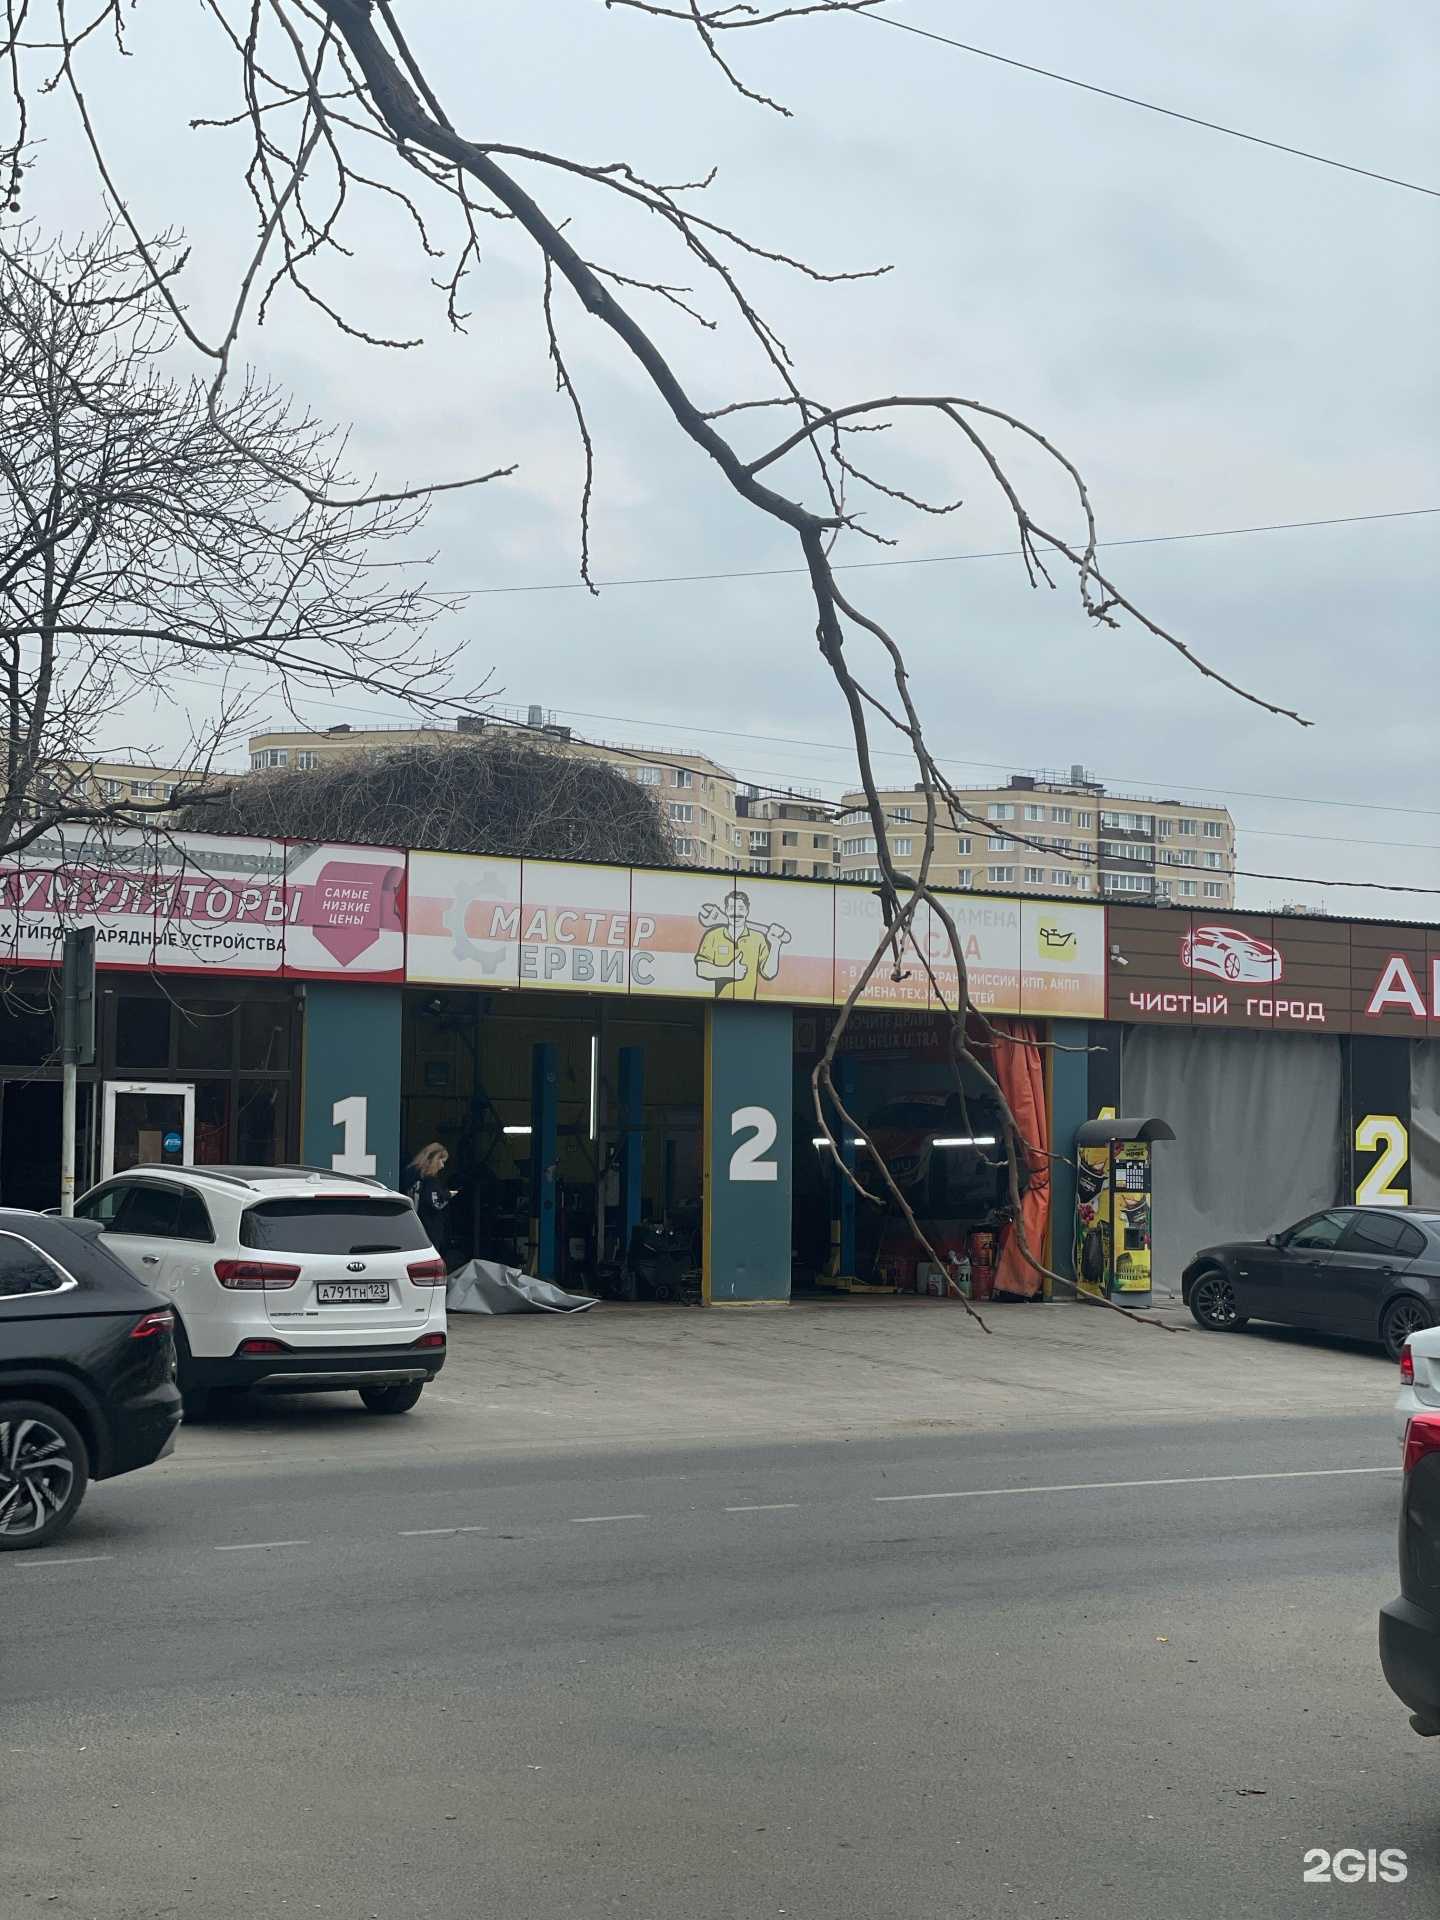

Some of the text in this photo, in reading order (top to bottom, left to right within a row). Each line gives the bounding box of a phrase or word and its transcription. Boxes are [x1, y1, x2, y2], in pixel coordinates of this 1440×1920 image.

[322, 900, 371, 914] НИЗКИЕ
[324, 887, 370, 901] САМЫЕ
[328, 912, 365, 926] ЦЕНЫ
[488, 905, 656, 947] МАСТЕР
[95, 928, 178, 947] АРЯДНЫЕ
[181, 931, 287, 953] УСТРОЙСТВА
[1129, 992, 1325, 1022] ЧИСТЫЙ ГОРОД
[331, 1096, 376, 1176] 1
[729, 1106, 778, 1181] 2
[1355, 1114, 1409, 1206] 2
